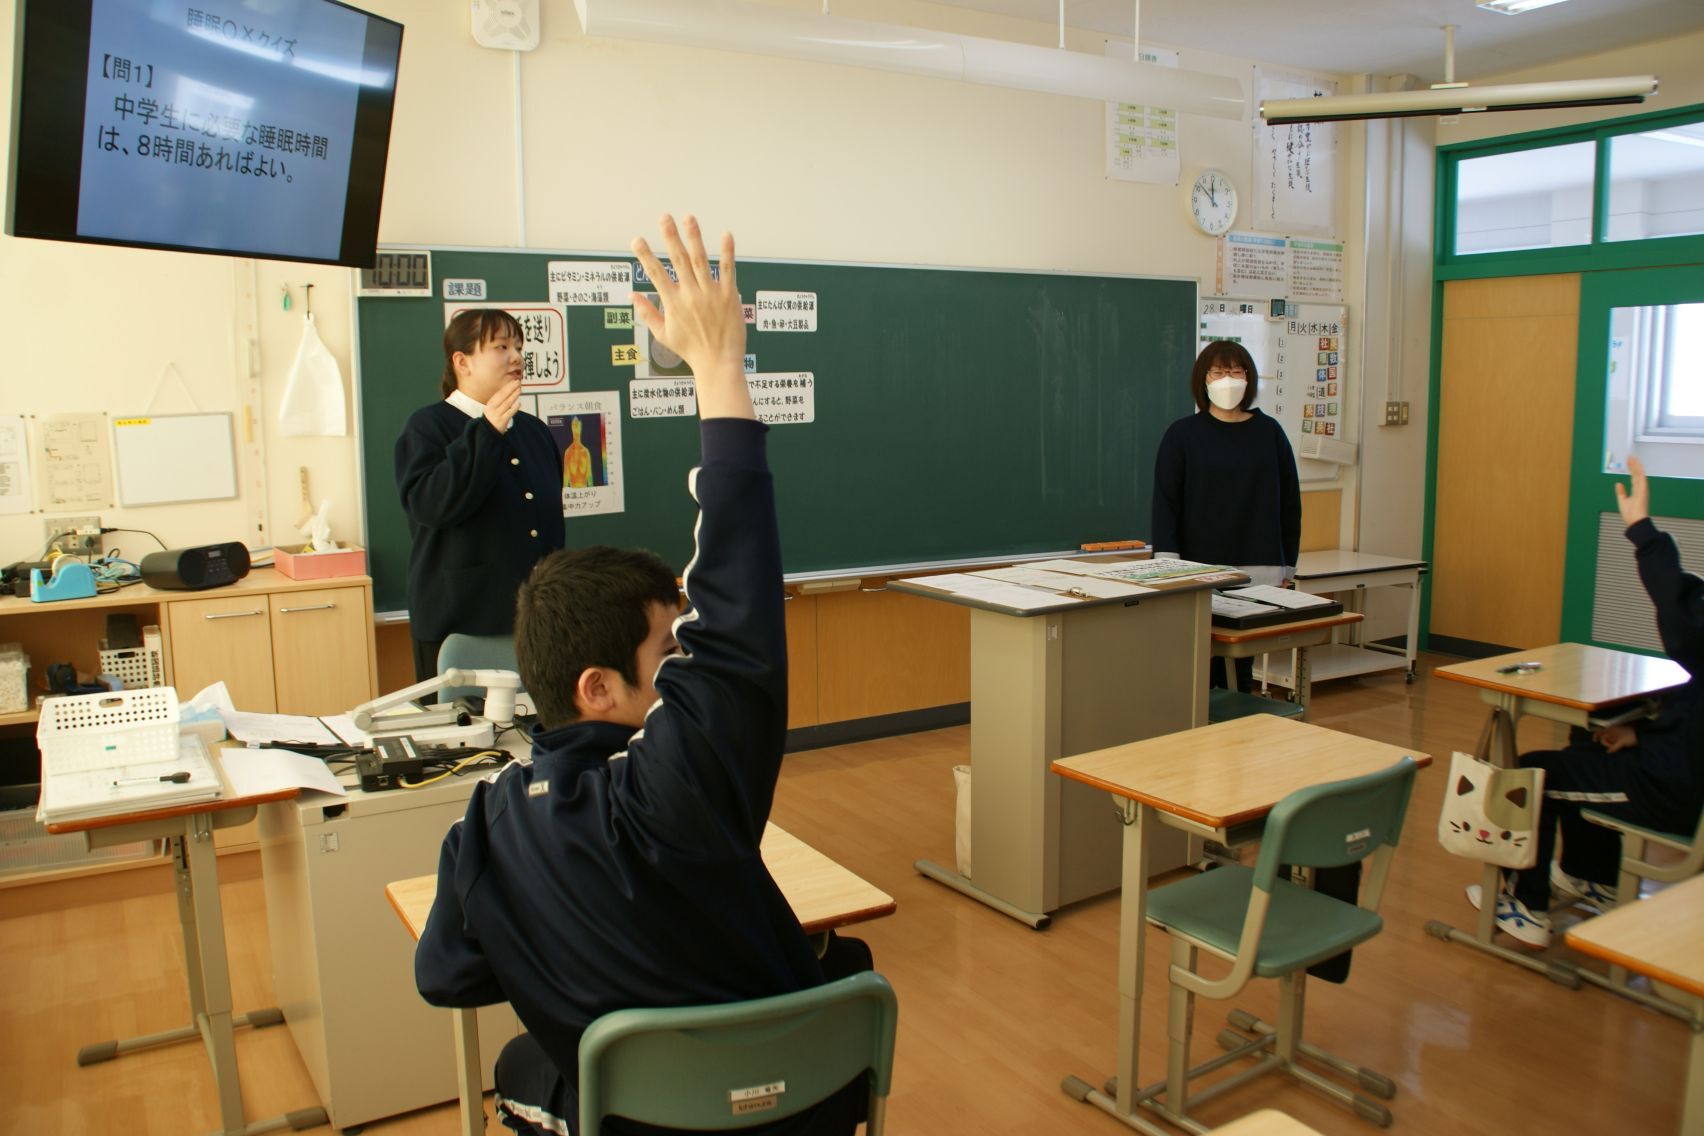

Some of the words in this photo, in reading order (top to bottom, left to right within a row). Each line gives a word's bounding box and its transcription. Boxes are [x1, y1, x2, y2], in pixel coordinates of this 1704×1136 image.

[102, 53, 154, 88] 【問1】
[114, 93, 329, 160] 中学生に必要な睡眠時間
[98, 124, 294, 183] は、8時間あればよい。
[448, 283, 482, 297] 課題
[758, 299, 814, 311] 主にたんぱく質の供給源
[1220, 304, 1225, 312] 日
[1240, 304, 1252, 313] 曜日
[607, 312, 631, 324] 副菜
[744, 307, 753, 319] 菜
[517, 315, 551, 344] を送り
[1290, 321, 1296, 332] 月
[1300, 322, 1307, 333] 火
[1311, 324, 1317, 333] 水
[1322, 324, 1328, 333] 木
[1331, 323, 1338, 333] 金
[614, 347, 638, 361] 主食
[632, 387, 694, 399] 主に炭水化物の供給源
